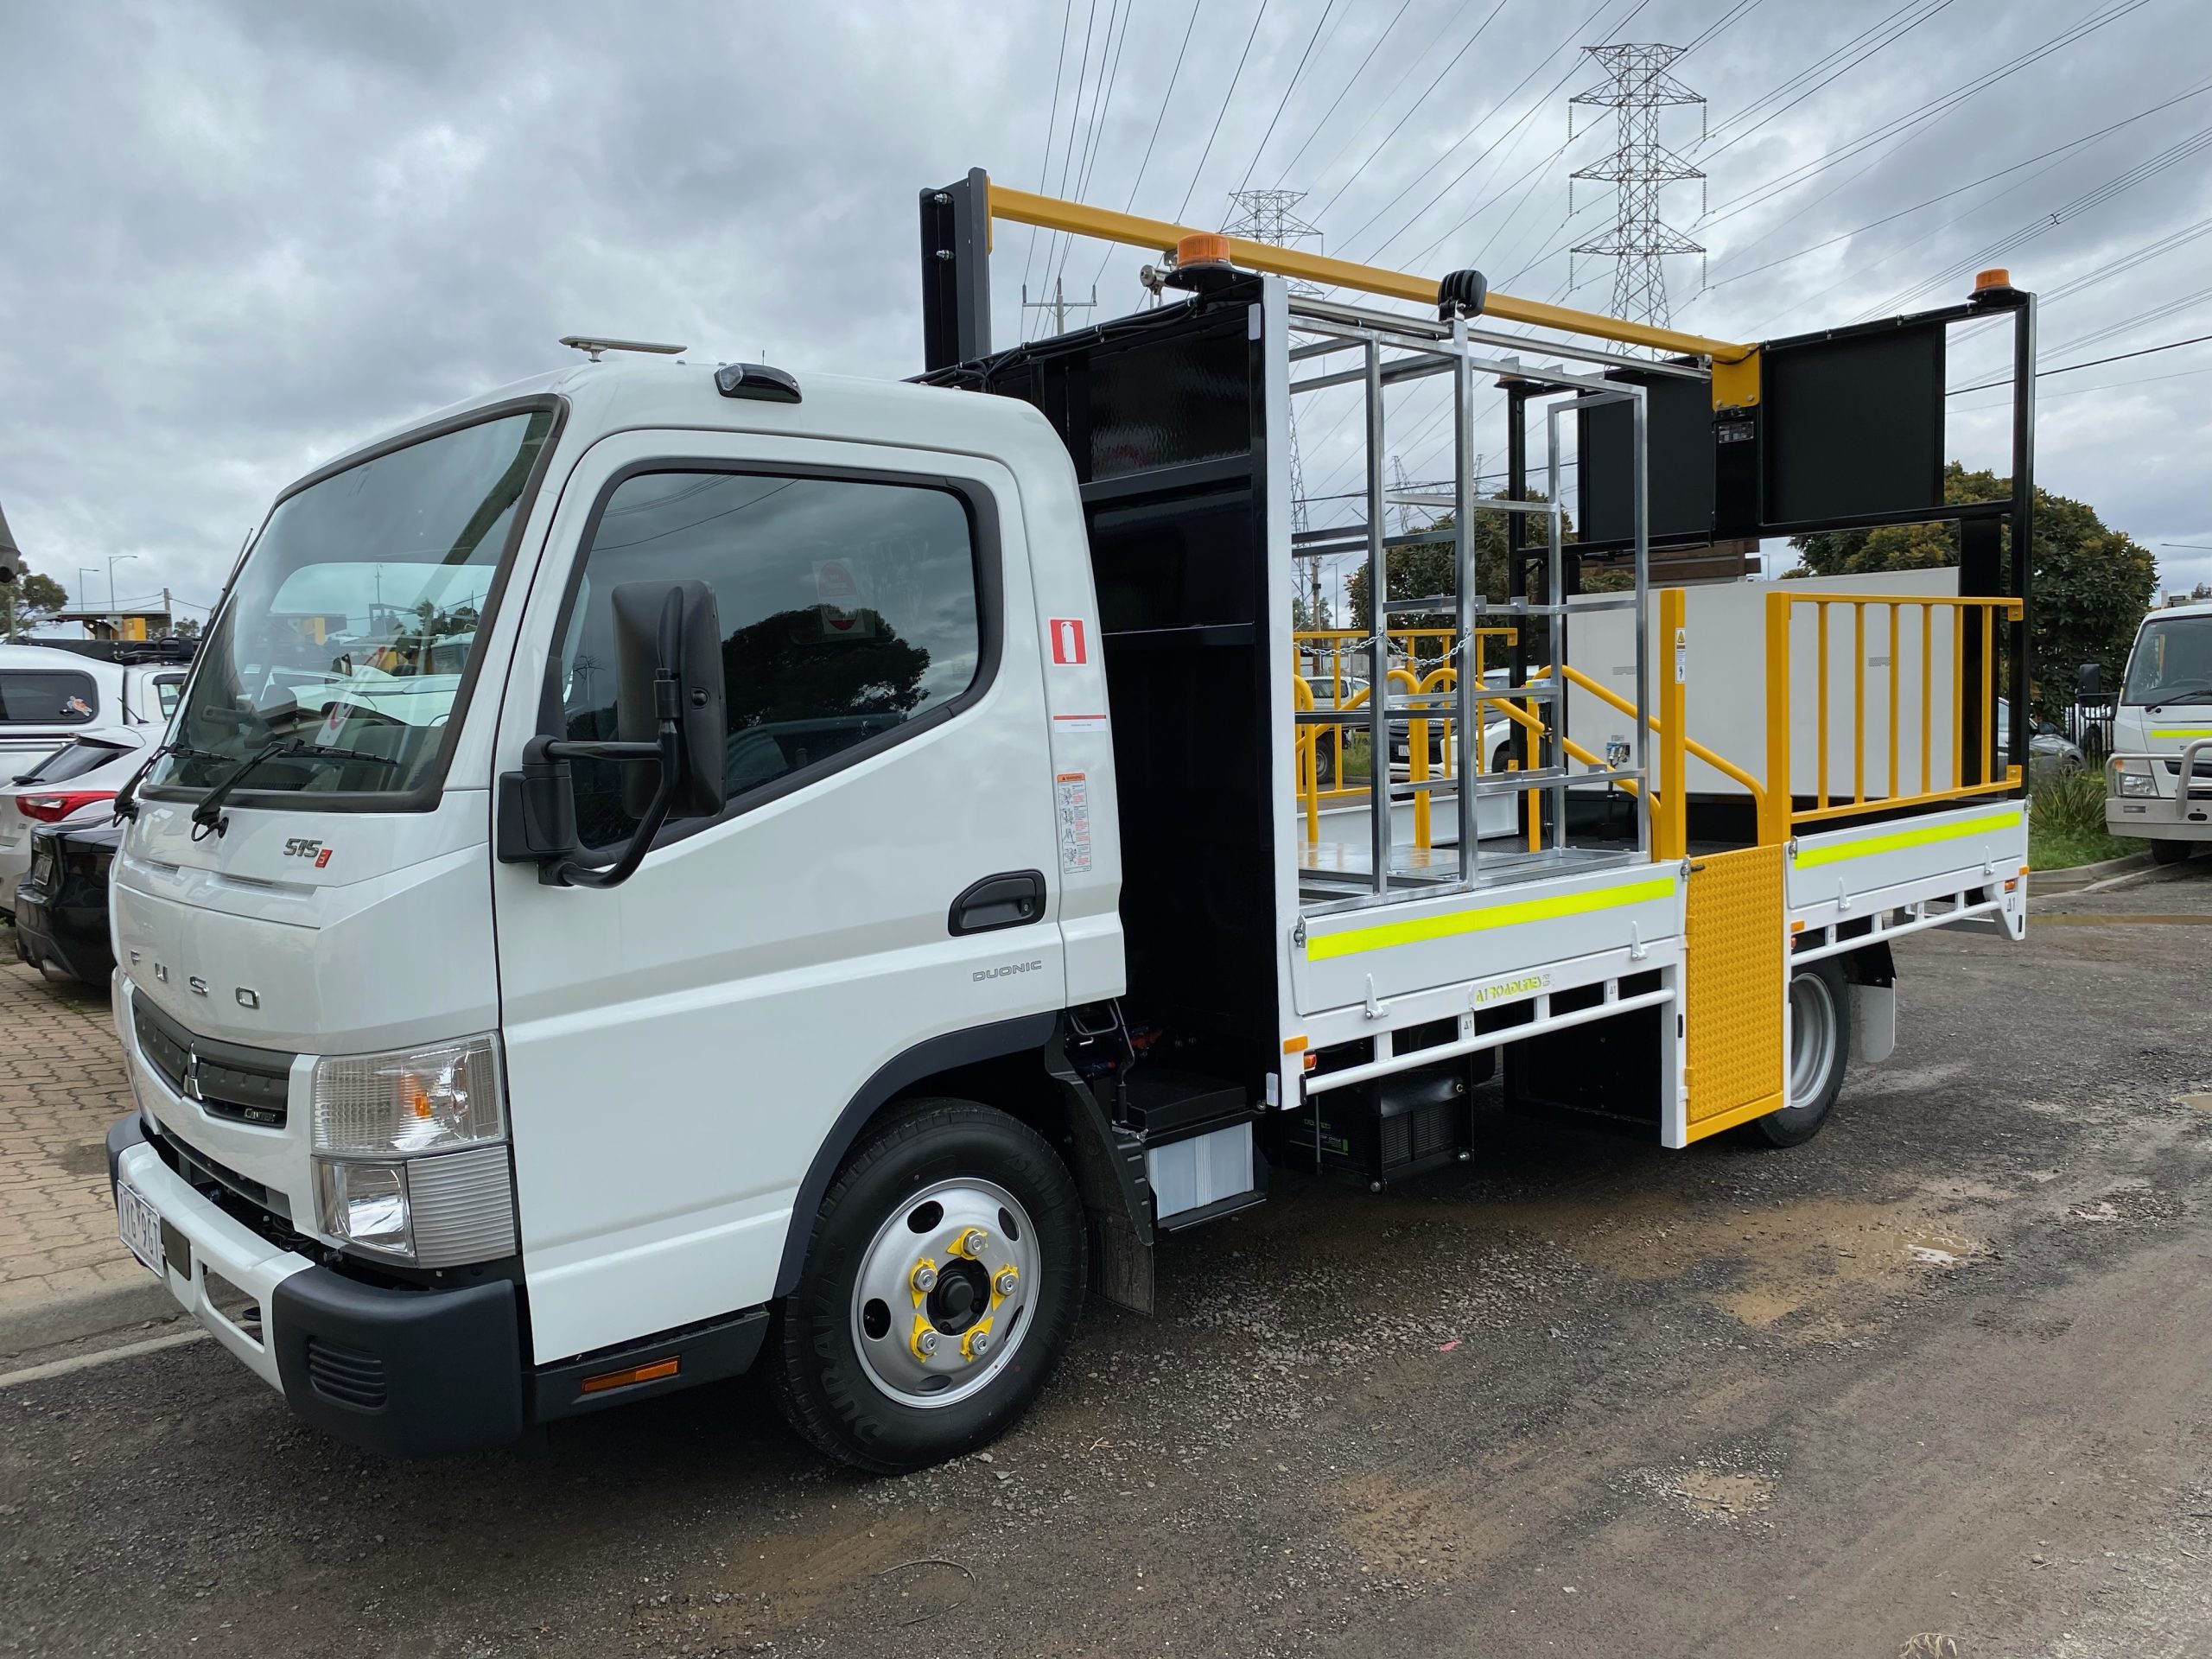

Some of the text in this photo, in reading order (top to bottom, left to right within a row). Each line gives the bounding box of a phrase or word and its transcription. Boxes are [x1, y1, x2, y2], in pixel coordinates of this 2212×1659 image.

[283, 838, 323, 858] 515
[130, 950, 260, 1010] FUSO
[973, 960, 1042, 982] DUONIC
